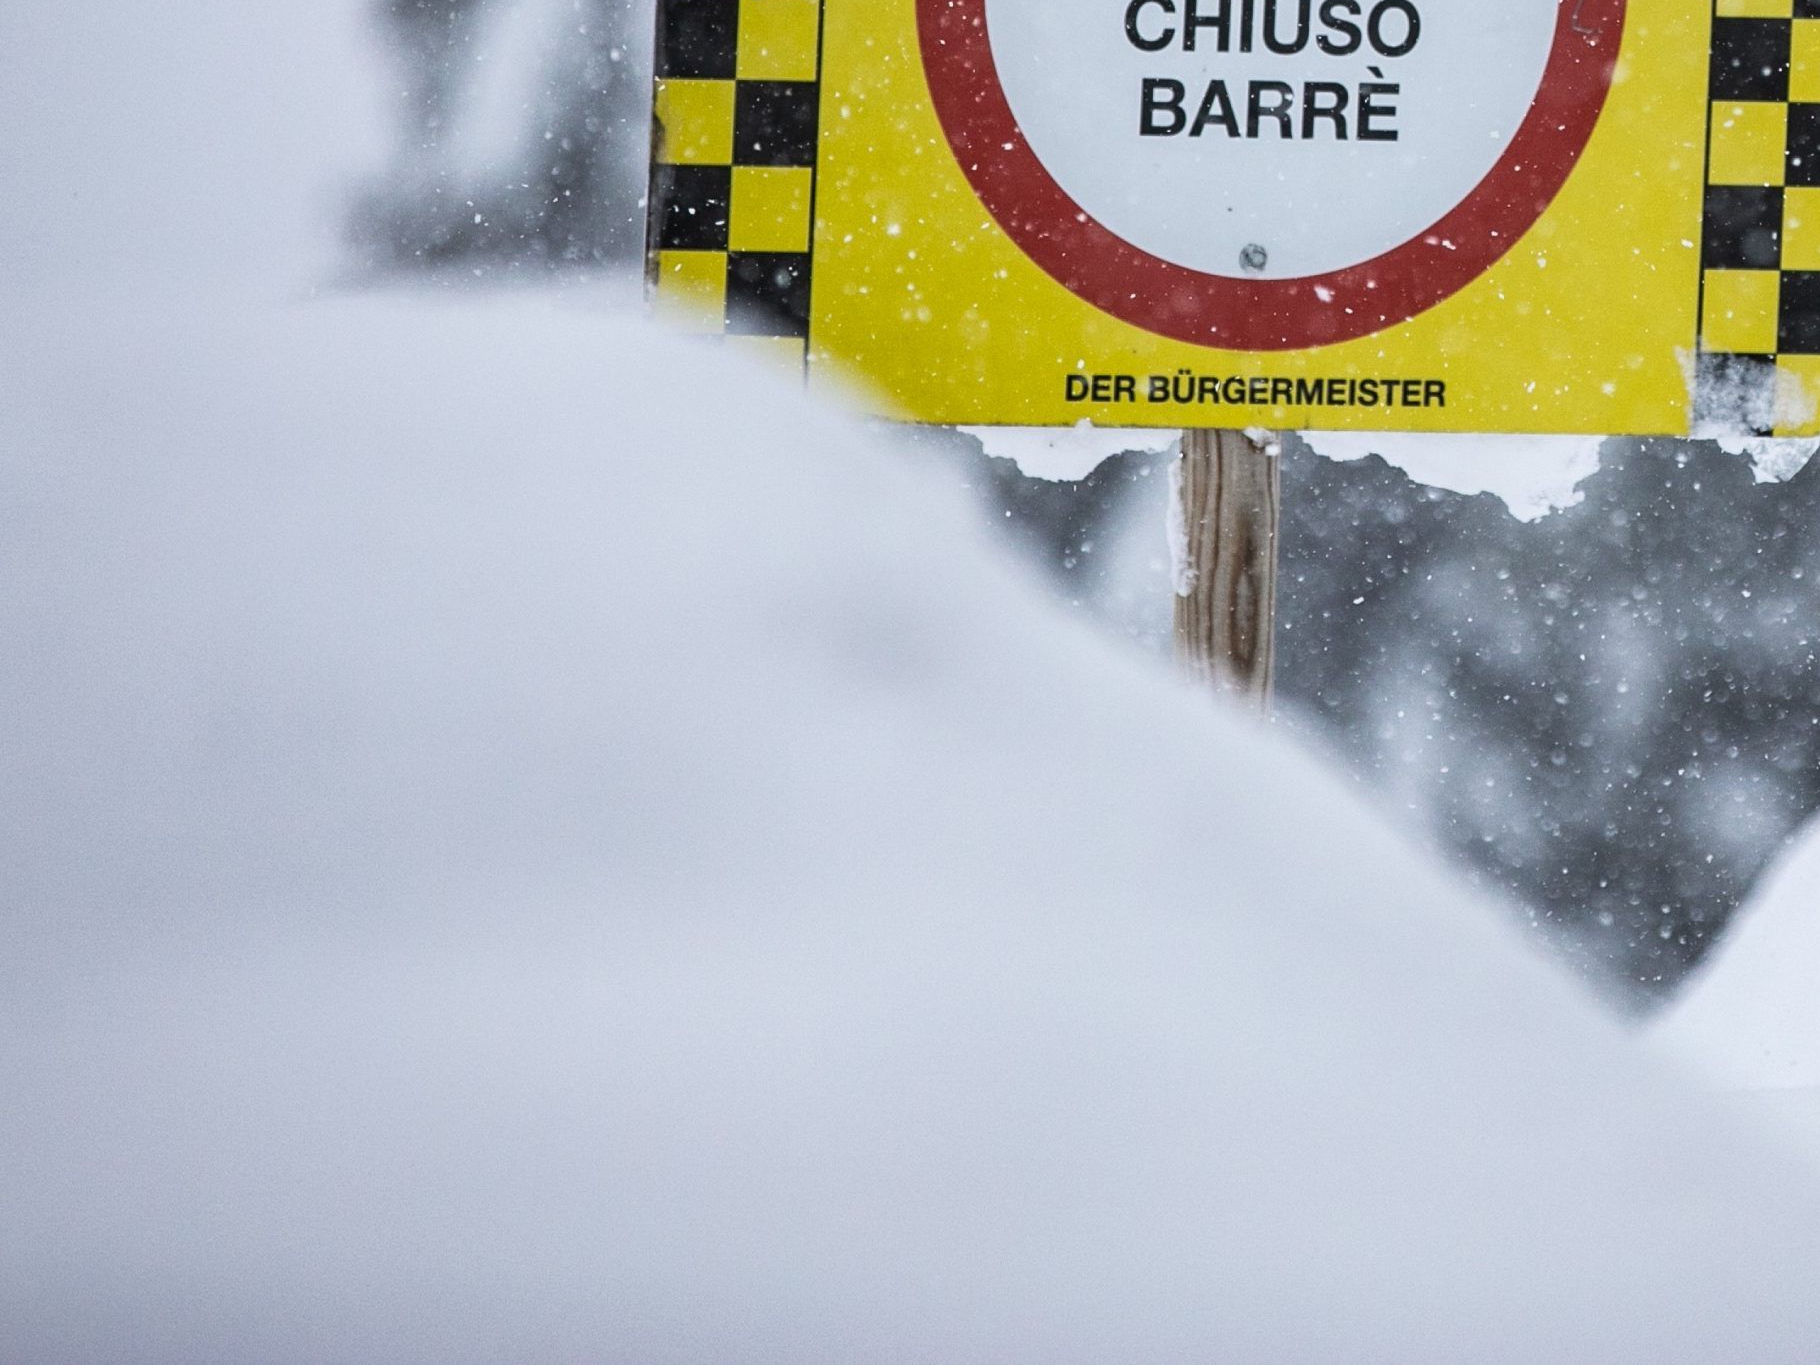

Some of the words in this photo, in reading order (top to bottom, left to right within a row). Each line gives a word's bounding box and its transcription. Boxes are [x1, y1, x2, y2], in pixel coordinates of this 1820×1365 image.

[1139, 65, 1400, 141] BARRÈ
[1065, 374, 1136, 403] DER
[1148, 369, 1446, 407] BÜRGERMEISTER
